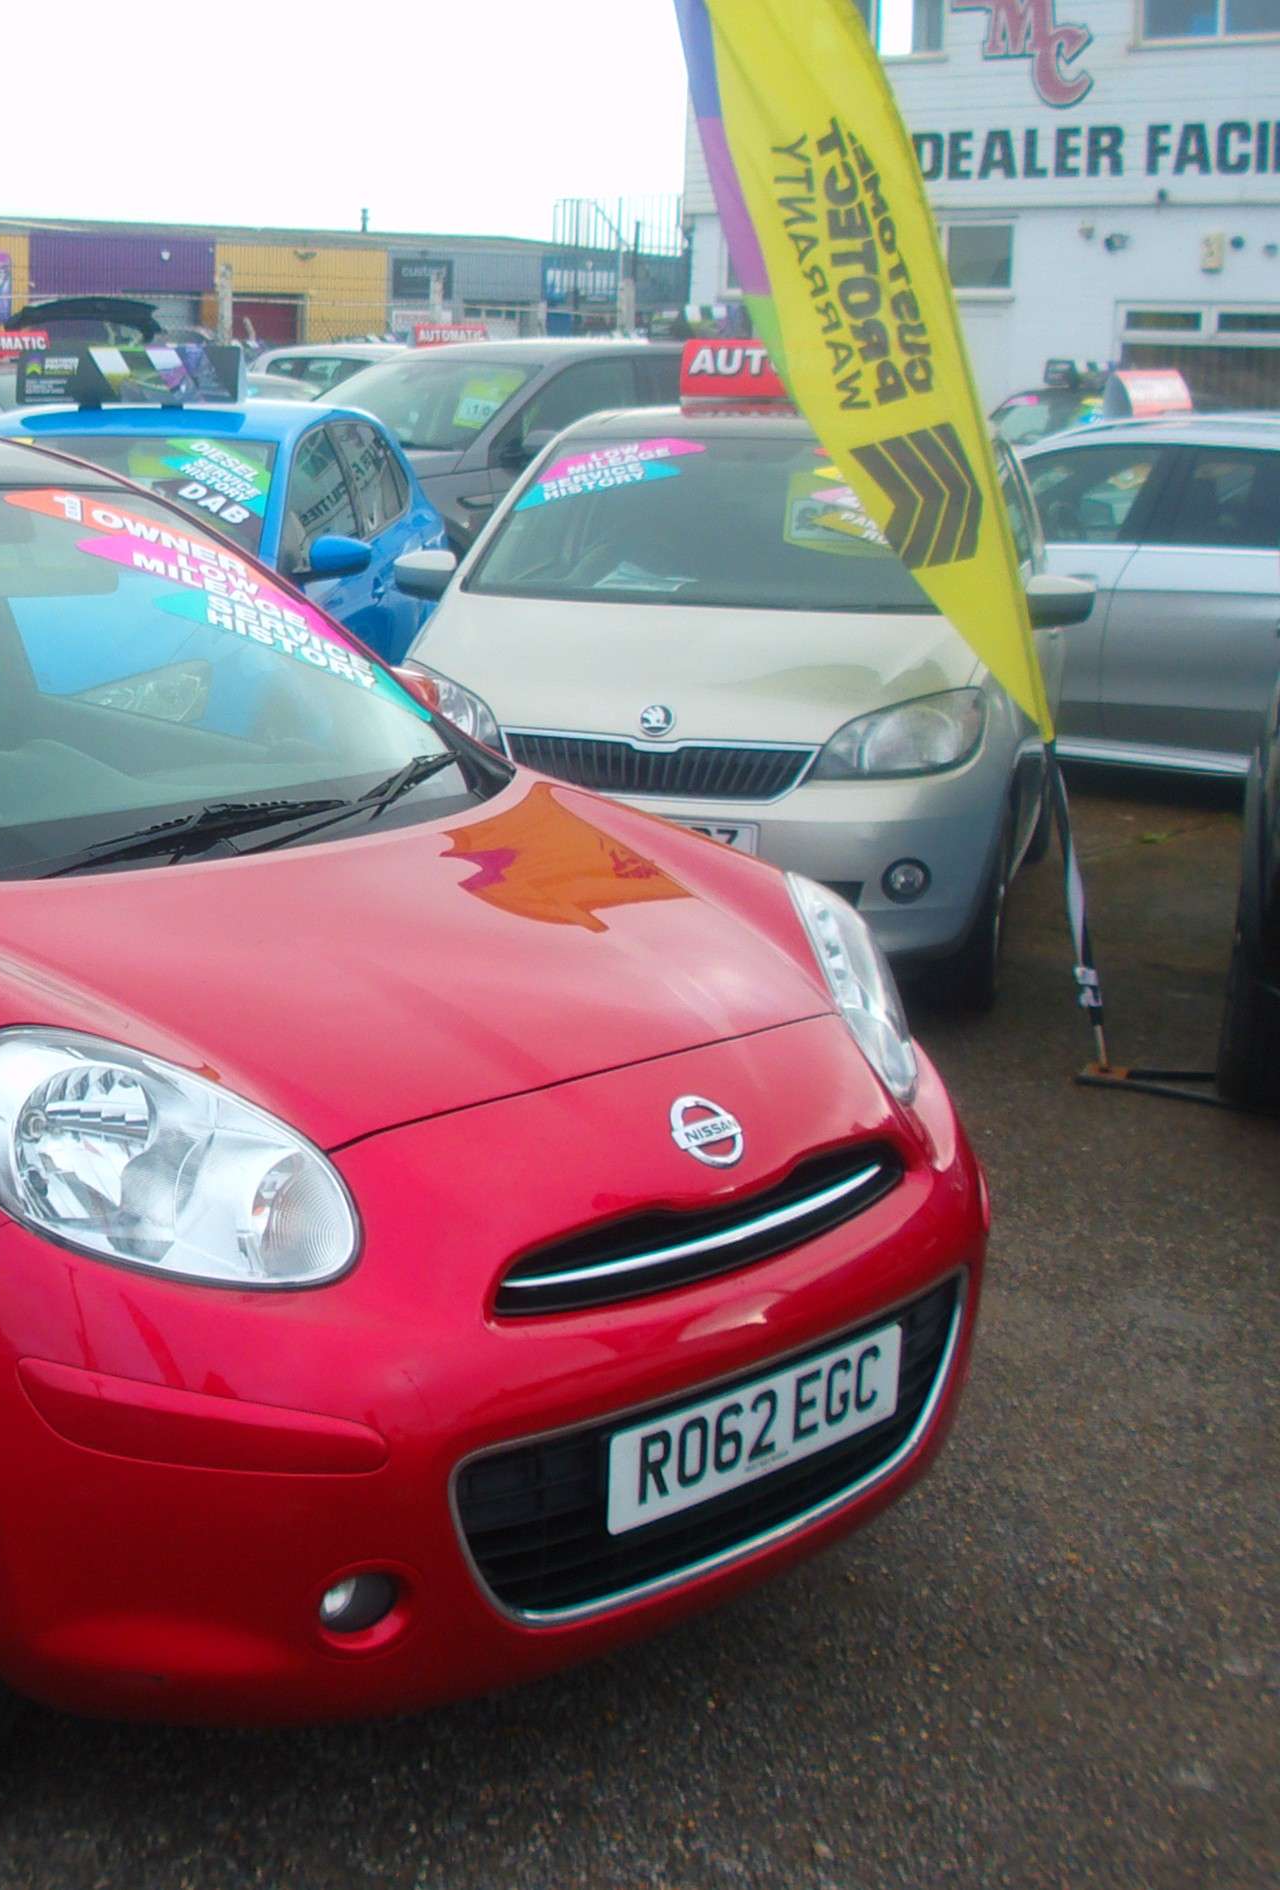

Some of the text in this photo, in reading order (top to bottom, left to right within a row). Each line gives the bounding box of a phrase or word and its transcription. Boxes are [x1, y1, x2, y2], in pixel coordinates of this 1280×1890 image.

[951, 0, 1095, 110] MC
[911, 125, 1125, 182] DEALER
[688, 347, 777, 375] AUT
[190, 441, 259, 482] DIESEL
[567, 447, 672, 474] MILEAGE
[590, 444, 640, 462] LOW
[180, 462, 254, 502] HISTORY
[193, 457, 262, 496] SERVICE
[543, 462, 644, 491] SERVICE
[543, 471, 646, 501] HISTORY
[177, 482, 250, 524] DAB
[92, 508, 248, 578] OWNER
[132, 551, 308, 630] MILEAGE
[177, 553, 259, 595] LOW
[207, 594, 375, 677] SERVICE
[207, 607, 376, 689] HISTORY
[638, 1345, 882, 1506] RO62 EGC
